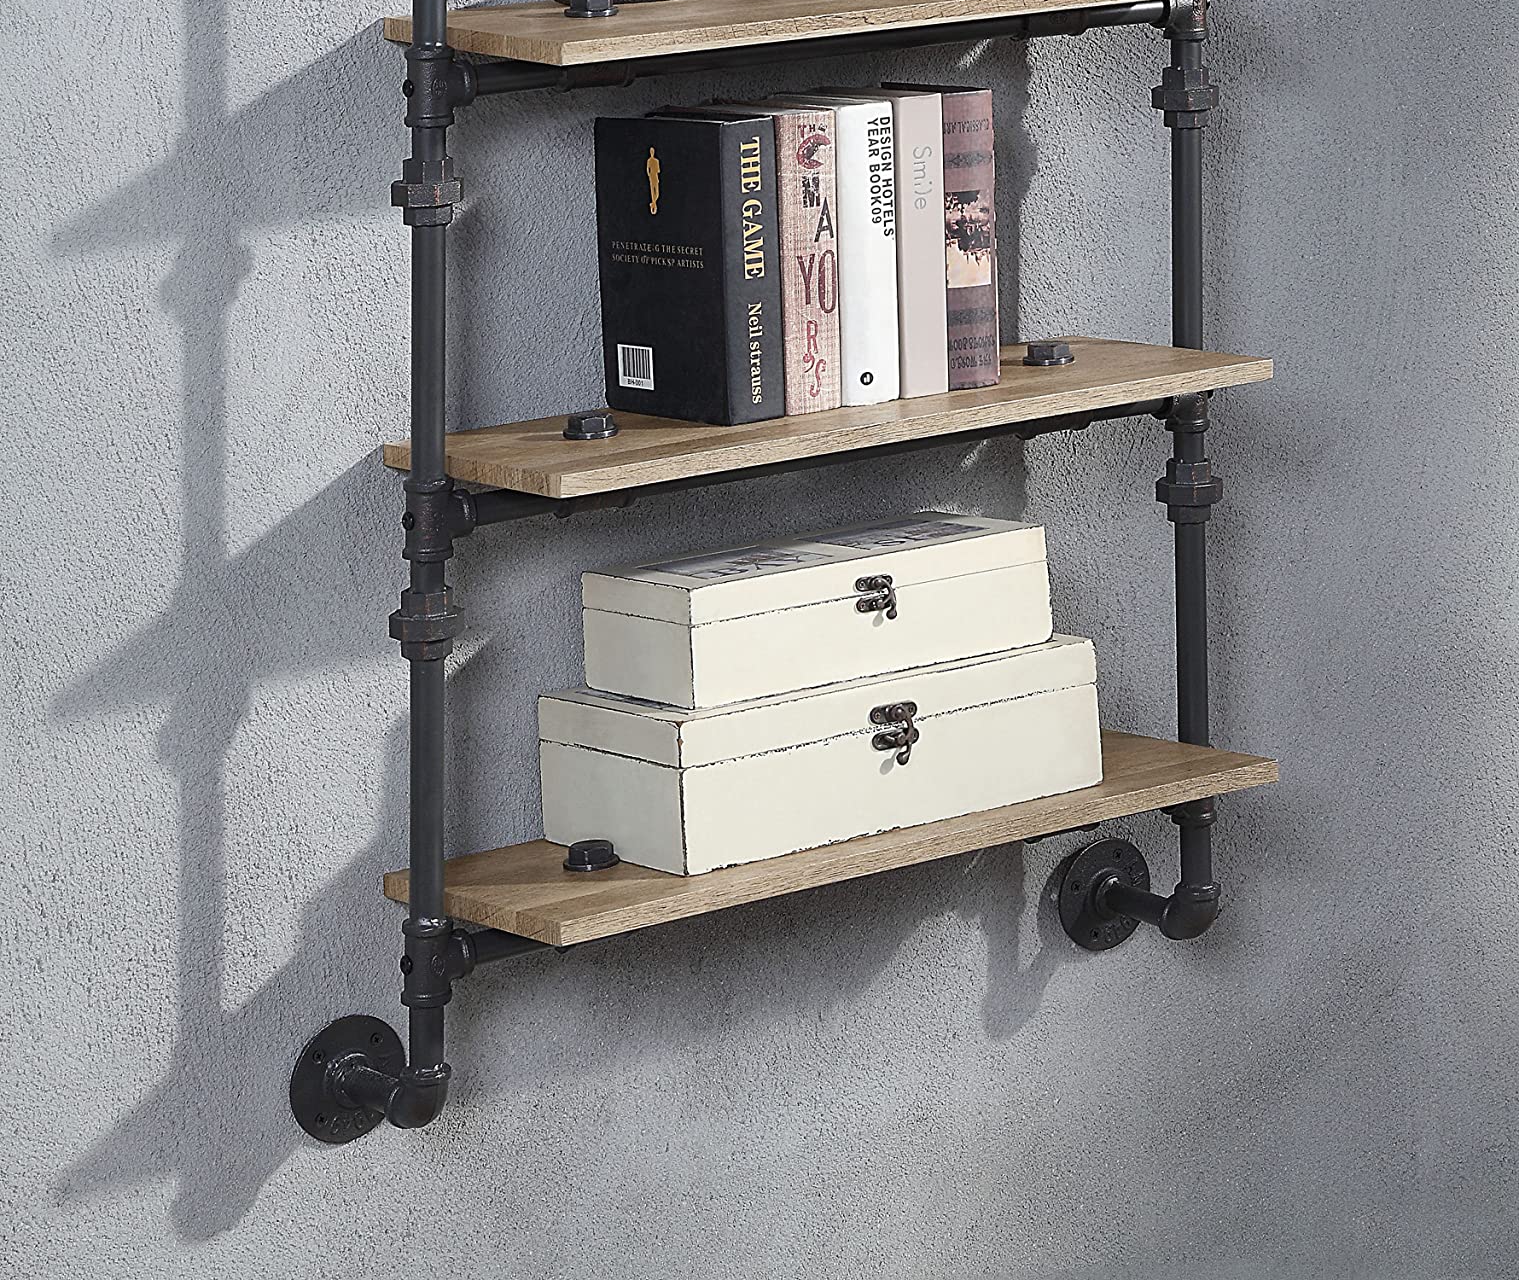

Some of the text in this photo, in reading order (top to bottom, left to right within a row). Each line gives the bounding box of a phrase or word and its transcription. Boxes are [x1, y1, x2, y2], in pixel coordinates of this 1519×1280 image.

[867, 117, 879, 158] YEAR
[879, 116, 894, 237] DESIGN HOTELS
[677, 245, 703, 257] SECRET
[740, 136, 765, 280] THE GAME
[747, 302, 763, 404] Neil strauss
